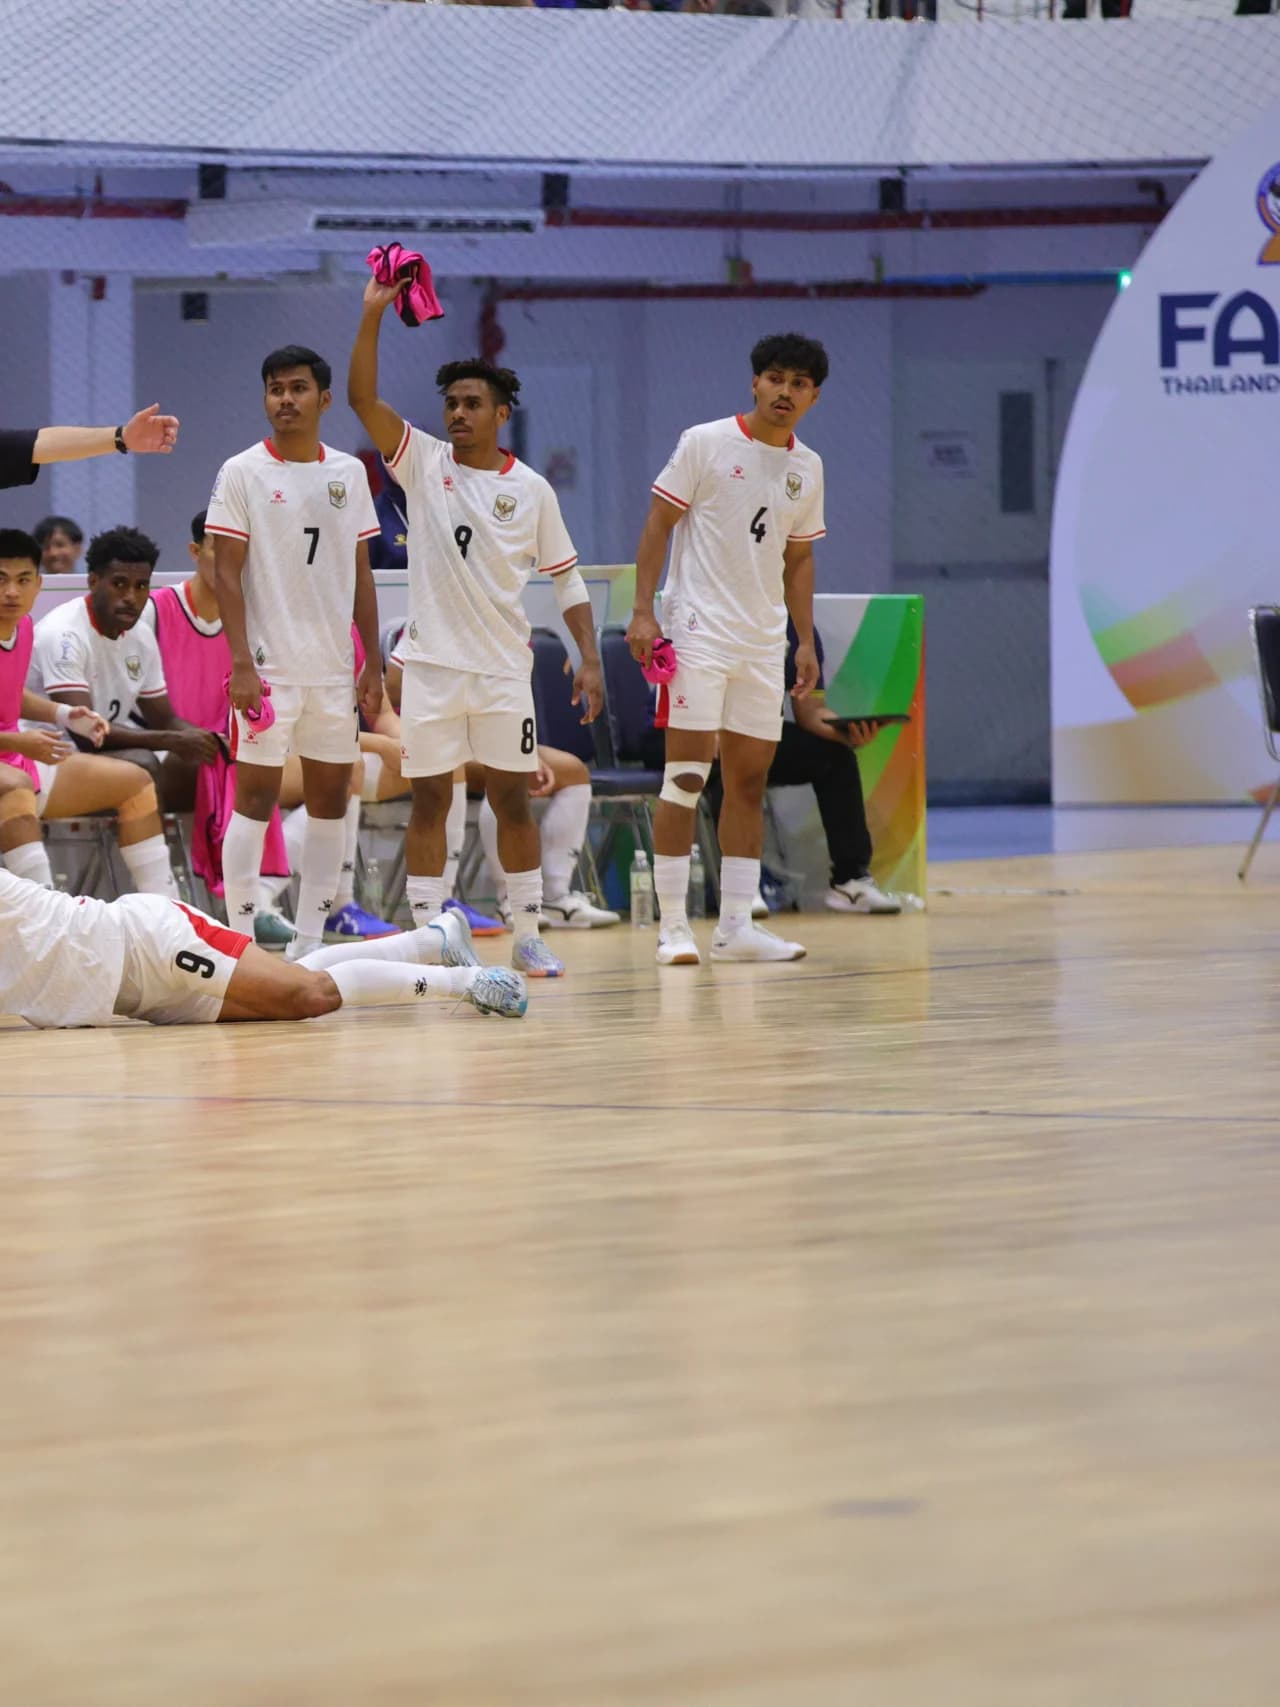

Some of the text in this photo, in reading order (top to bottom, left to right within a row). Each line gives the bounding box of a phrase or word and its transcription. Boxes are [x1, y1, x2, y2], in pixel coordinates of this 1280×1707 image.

[749, 506, 769, 543] 4
[304, 527, 320, 565] 7
[108, 699, 121, 722] 2
[520, 717, 535, 755] 8
[175, 950, 216, 979] 9
